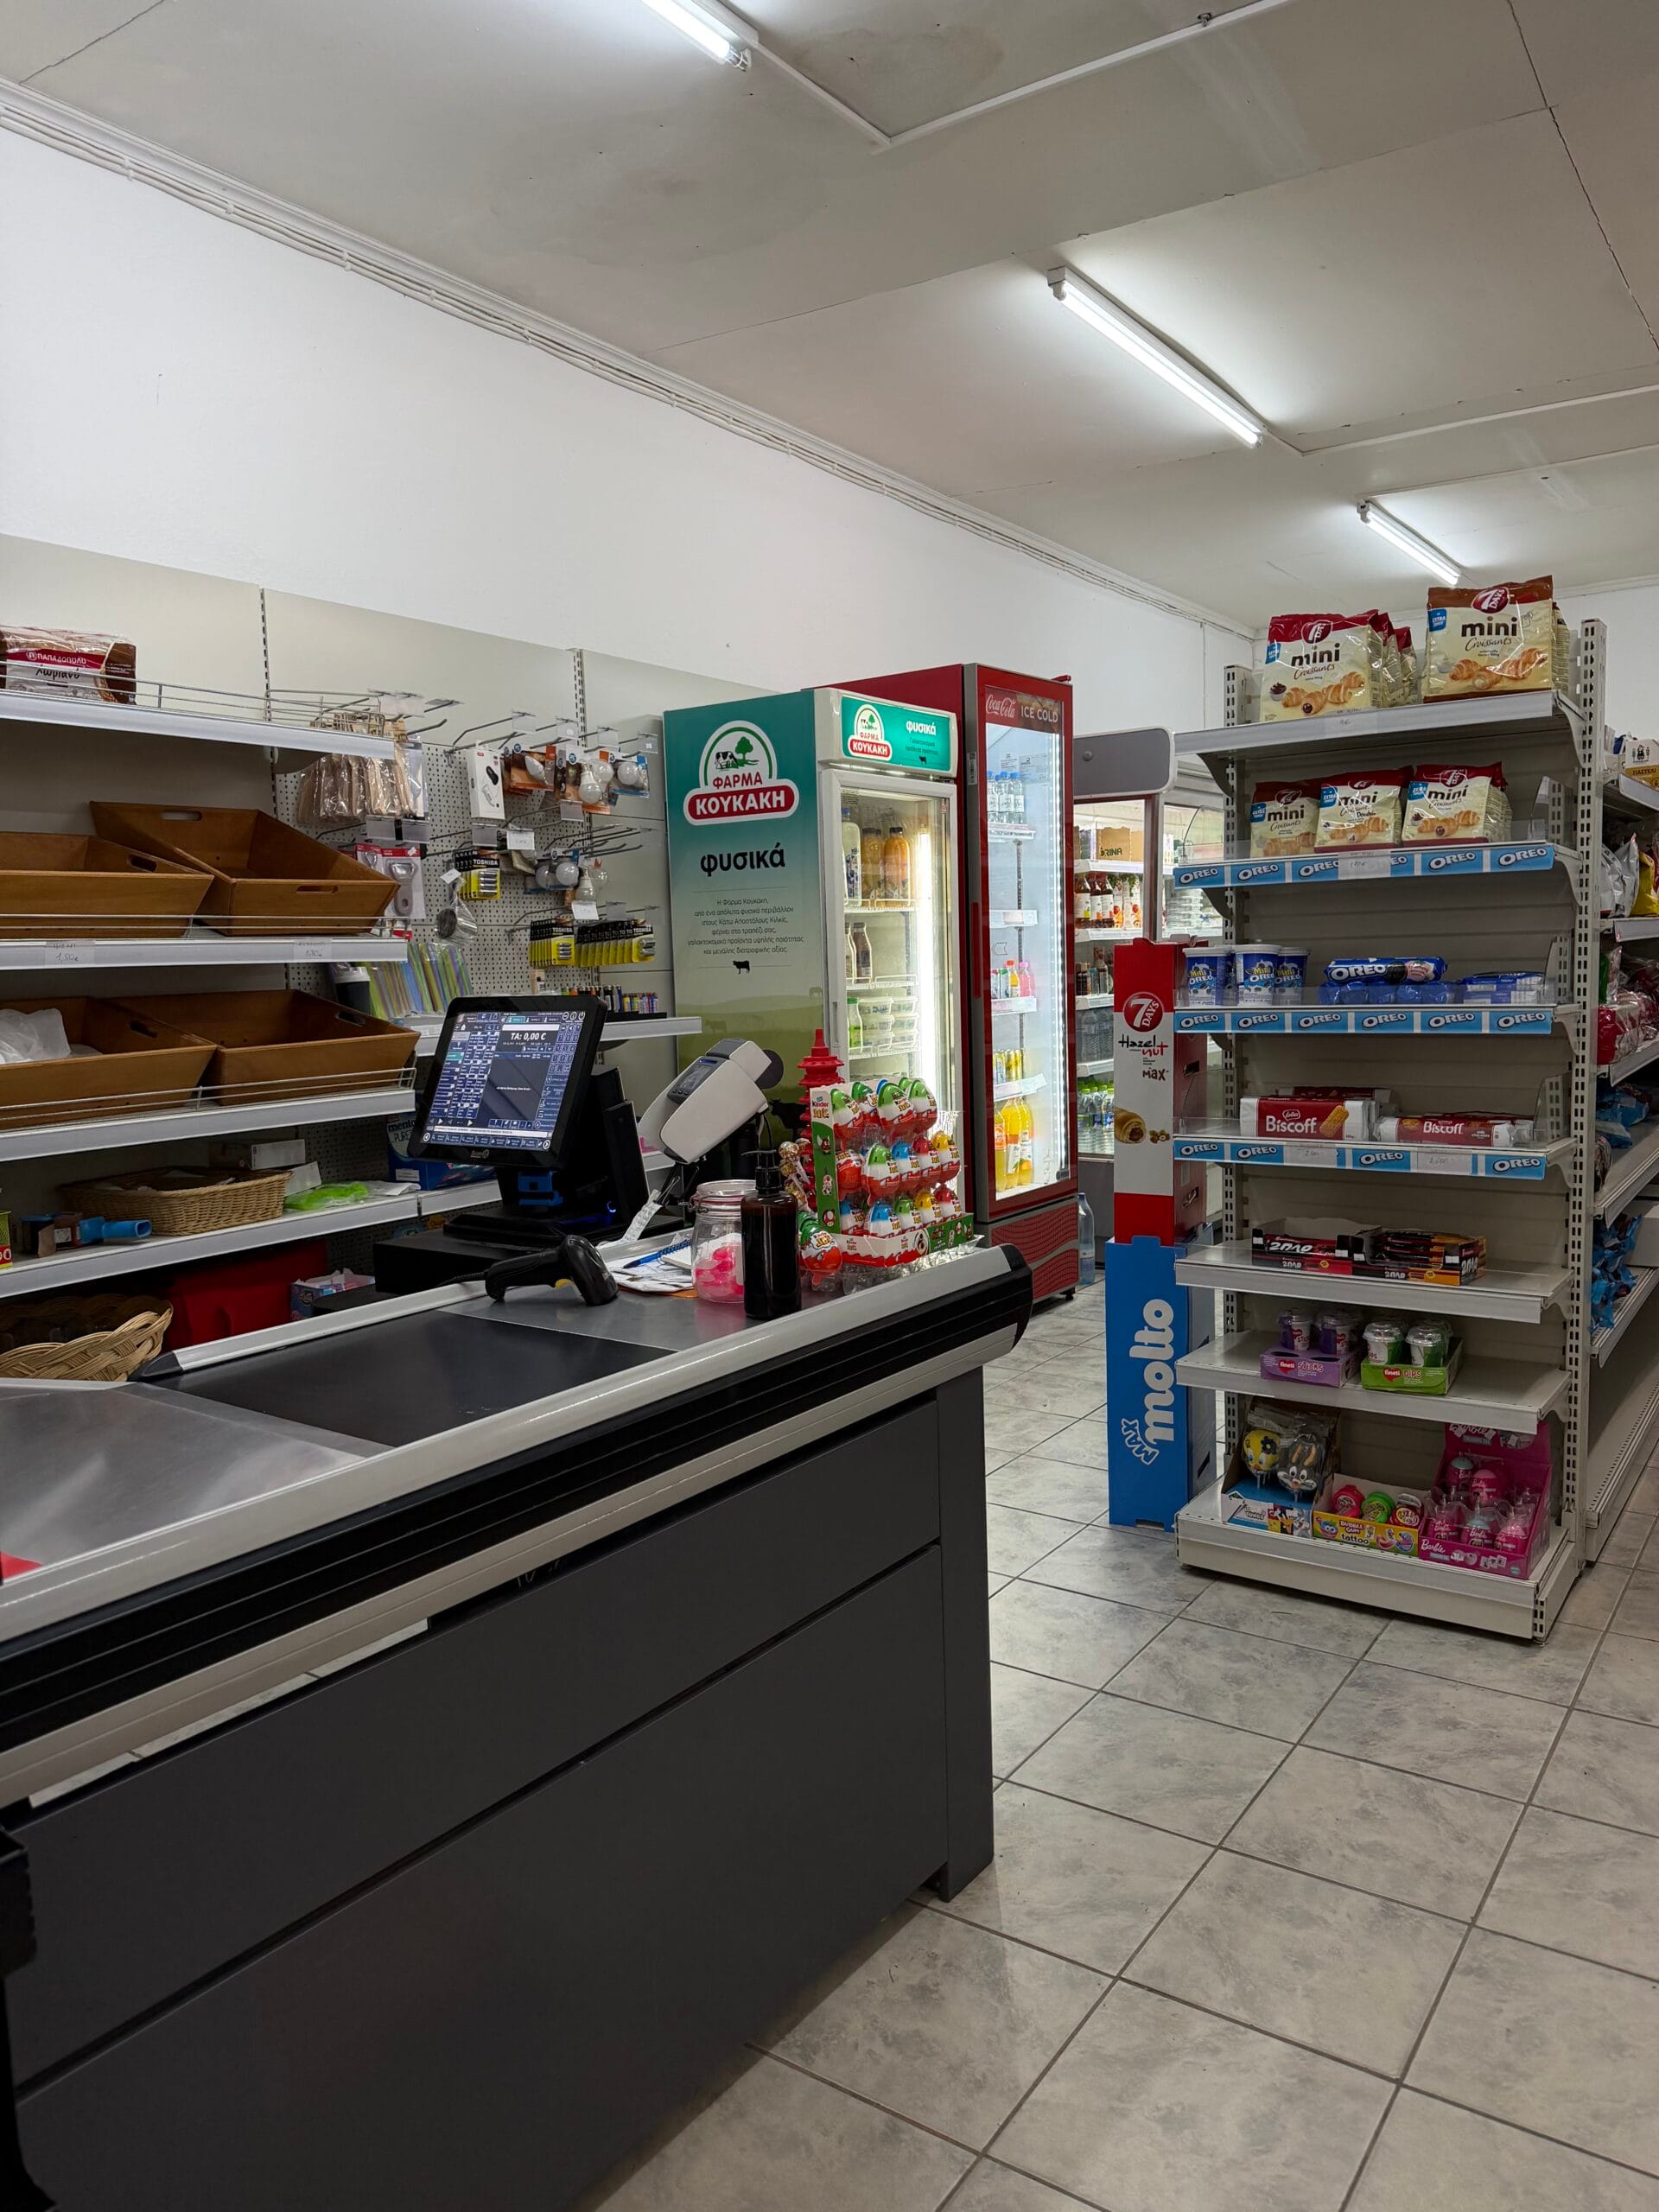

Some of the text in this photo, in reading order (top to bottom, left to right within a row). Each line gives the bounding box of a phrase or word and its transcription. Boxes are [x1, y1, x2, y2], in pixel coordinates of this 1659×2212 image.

[1476, 588, 1496, 610] 7
[1461, 616, 1517, 637] mini
[1465, 637, 1512, 652] Croissants
[1291, 643, 1340, 666] mini
[1294, 664, 1335, 680] Croissants
[1021, 705, 1058, 723] ICE COLD
[906, 721, 937, 735] φυσικά
[860, 732, 880, 741] ΦΑΡΜΑ
[853, 741, 888, 755] ΚΟΥΚΑΚΗ
[713, 772, 763, 789] ΦΑΡΜΑ
[1338, 791, 1378, 806] mini
[1428, 785, 1468, 800] mini
[696, 790, 785, 816] ΚΟΥΚΑΚΗ
[1268, 804, 1306, 821] mini
[700, 842, 785, 877] φυσικά
[1390, 856, 1408, 866] EO
[1429, 851, 1476, 869] OREO
[1498, 848, 1548, 866] OREO
[1179, 868, 1218, 885] OREO
[1237, 864, 1279, 881] OREO
[1189, 975, 1213, 985] OREO
[1249, 973, 1274, 982] OREO
[1274, 974, 1300, 984] OREO
[1330, 964, 1387, 981] OREO
[1129, 998, 1160, 1027] 7 DAYS
[1180, 1014, 1219, 1028] OREO
[1238, 1014, 1279, 1028] OREO
[1299, 1014, 1342, 1028] OREO
[1362, 1013, 1407, 1028] OREO
[1428, 1013, 1475, 1029] OREO
[1497, 1013, 1546, 1029] OREO
[523, 1033, 540, 1041] 0,00
[1118, 1033, 1156, 1048] Hazel
[1141, 1041, 1168, 1058] nut
[388, 1120, 415, 1132] mento
[1266, 1116, 1317, 1134] Biscoff
[1423, 1121, 1465, 1135] Biscoff
[1180, 1143, 1218, 1156] OREO
[1237, 1147, 1277, 1159] OREO
[1359, 1152, 1404, 1165] OREO
[1493, 1158, 1541, 1172] OREO
[1129, 1299, 1174, 1445] molto
[1298, 1361, 1324, 1373] STICKS
[1402, 1370, 1422, 1379] DIPS
[1122, 1418, 1160, 1465] MAX
[1340, 1521, 1363, 1529] BUBBLE
[1341, 1534, 1370, 1545] tattoo
[1421, 1539, 1446, 1554] Barbie
